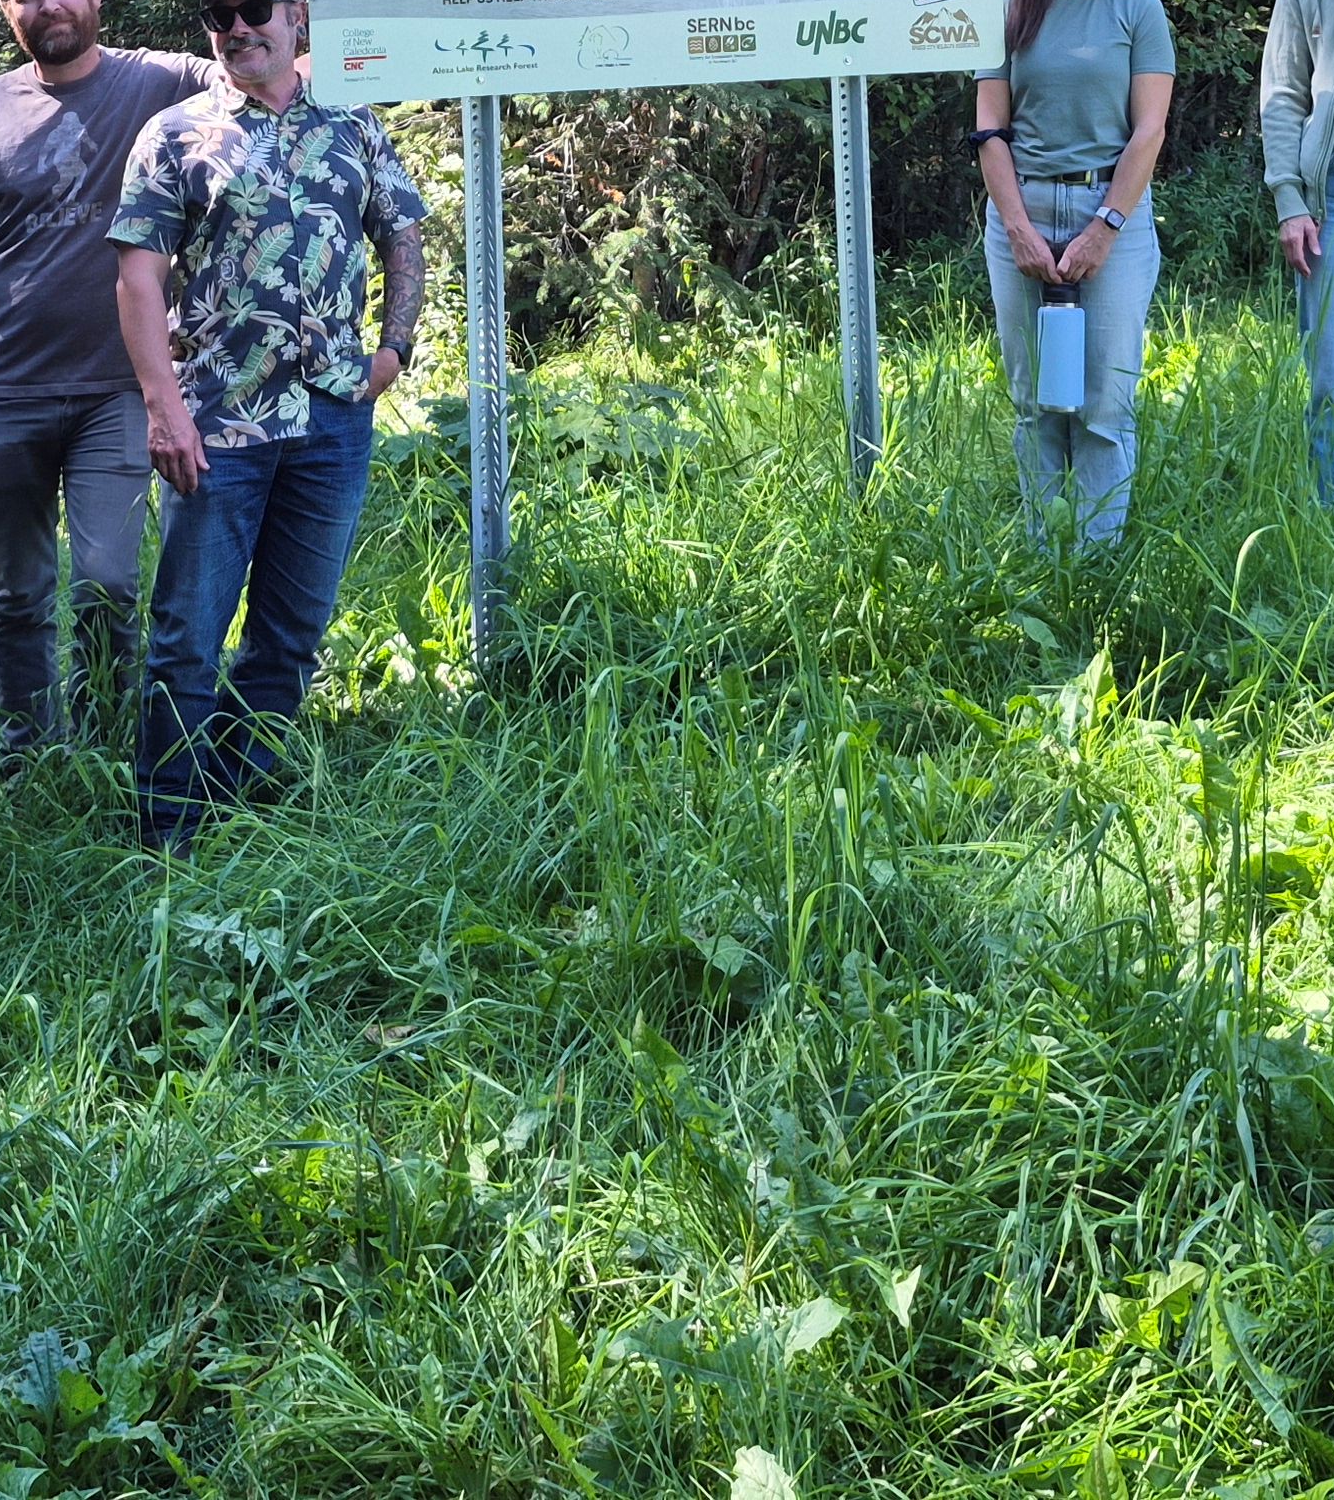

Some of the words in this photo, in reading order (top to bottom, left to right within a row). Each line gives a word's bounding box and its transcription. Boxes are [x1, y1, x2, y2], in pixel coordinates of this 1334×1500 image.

[342, 27, 374, 38] College
[796, 10, 868, 55] UNBC
[909, 24, 980, 45] SCWA
[342, 38, 351, 47] of
[352, 37, 373, 47] New
[342, 46, 387, 56] Caledonia
[343, 61, 364, 71] CNC
[456, 65, 475, 74] Lake
[476, 62, 512, 72] Research
[513, 62, 538, 70] Forest
